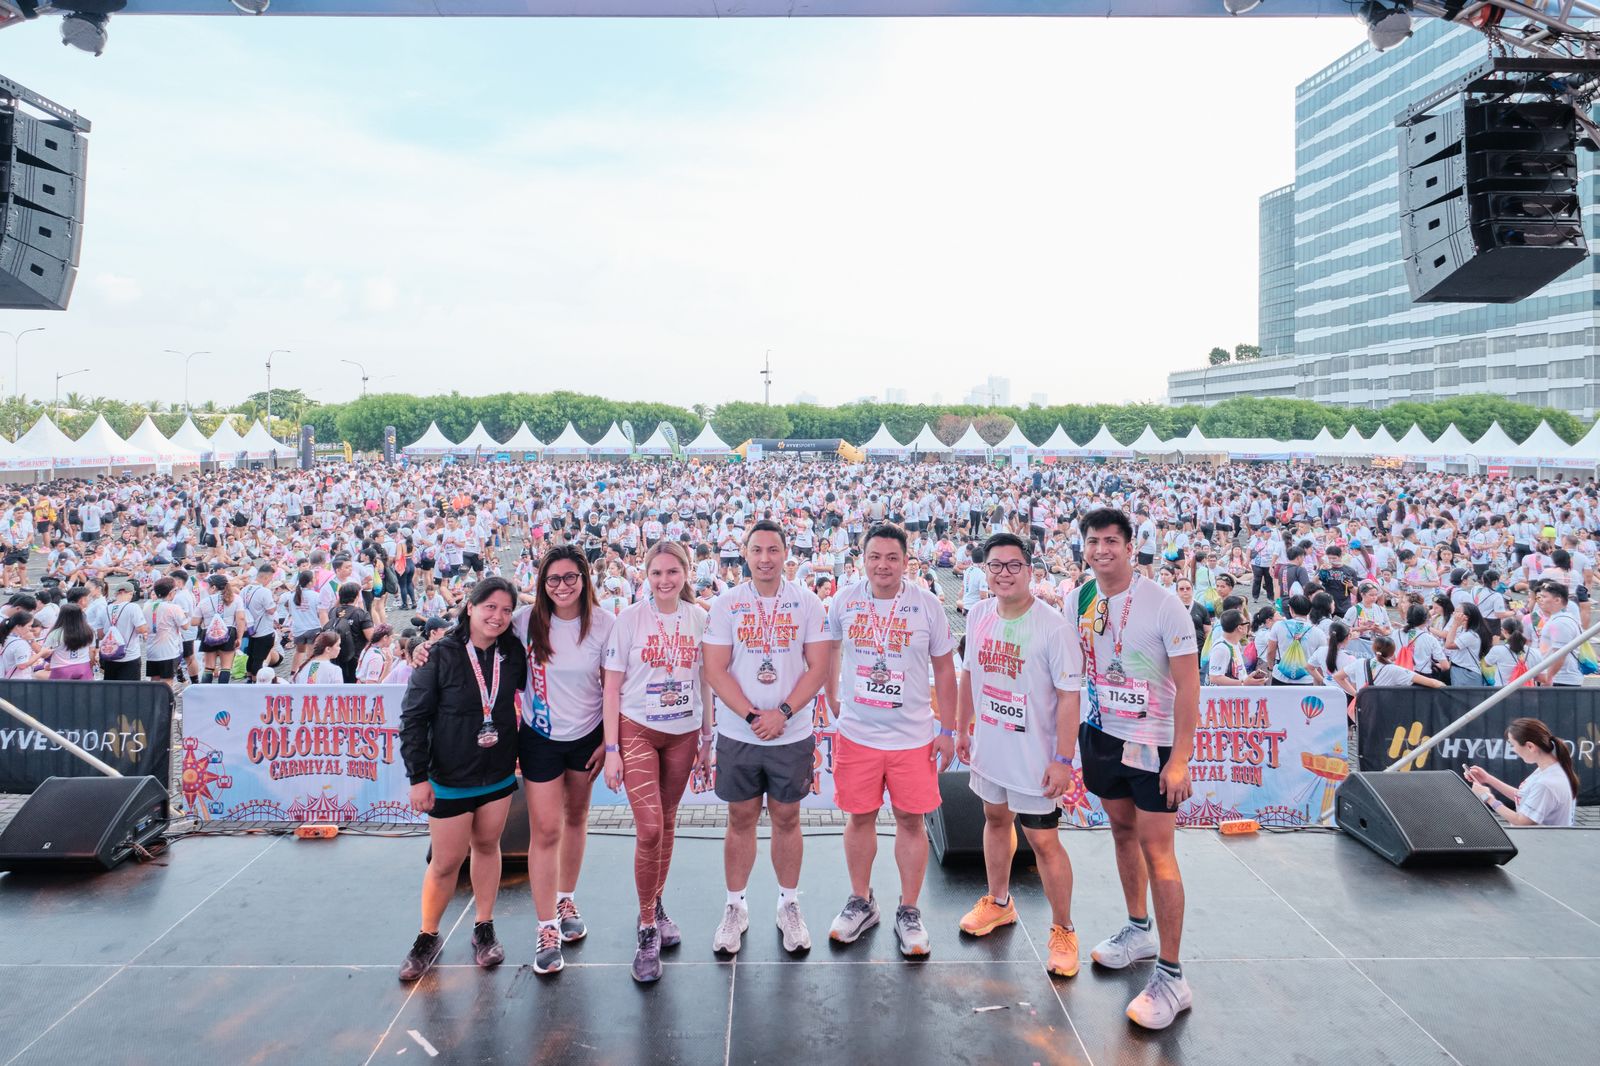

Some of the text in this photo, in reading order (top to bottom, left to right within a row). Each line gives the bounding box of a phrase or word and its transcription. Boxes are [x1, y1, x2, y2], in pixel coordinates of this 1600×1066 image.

[866, 682, 901, 696] 12262
[1108, 690, 1146, 706] 11435
[260, 695, 386, 725] JCI MANILA
[990, 700, 1024, 719] 12605
[246, 725, 400, 765] COLORFEST
[269, 760, 378, 781] CARNIVAL RUN
[1230, 765, 1263, 787] RUN
